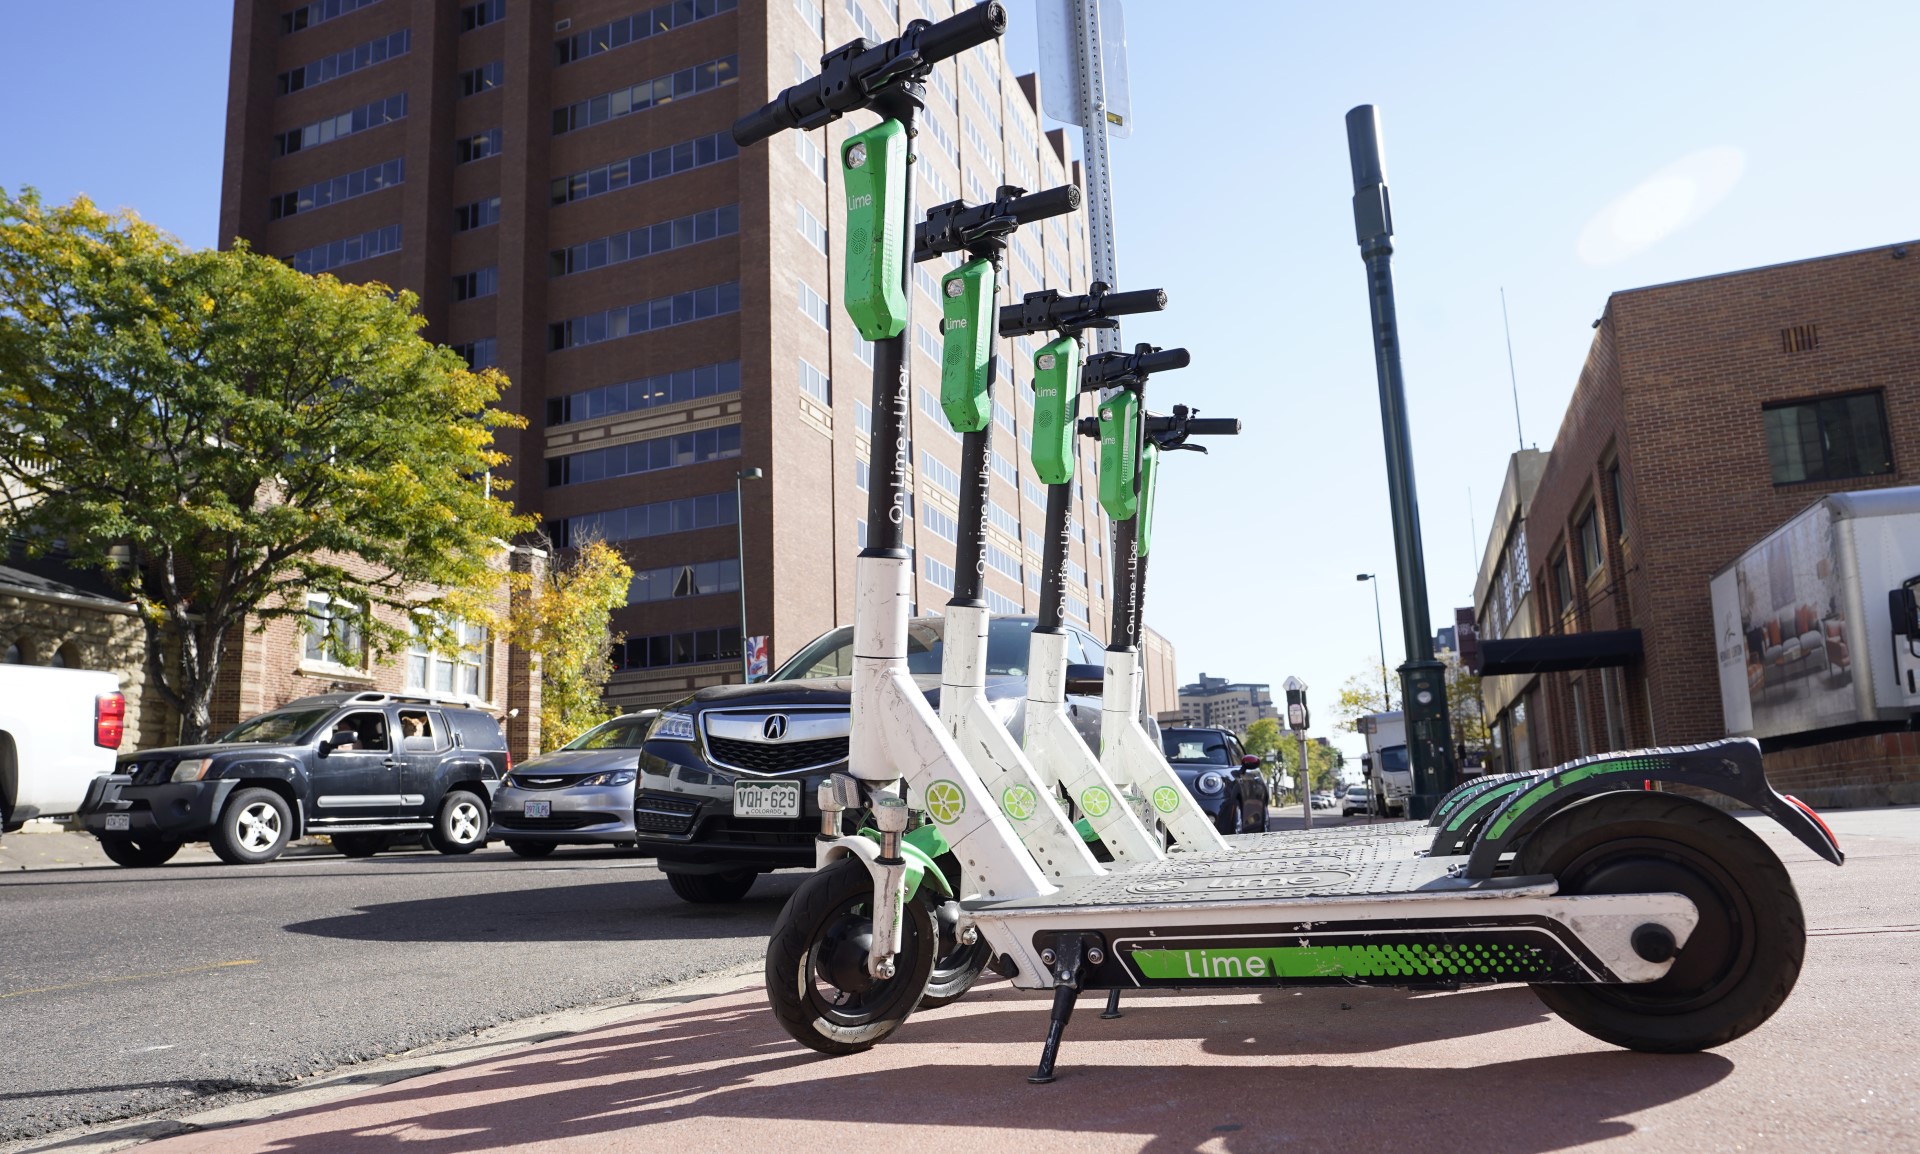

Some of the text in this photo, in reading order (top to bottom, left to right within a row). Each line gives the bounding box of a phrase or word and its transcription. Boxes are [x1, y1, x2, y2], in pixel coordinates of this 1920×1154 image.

[848, 193, 872, 211] Lime
[945, 317, 967, 330] Lime
[894, 364, 910, 416] Uber
[1036, 386, 1058, 397] Lime
[1101, 435, 1116, 445] Lime
[890, 436, 906, 487] Lime
[979, 447, 991, 487] Uber
[889, 492, 904, 524] On
[977, 506, 988, 547] Lime
[1061, 509, 1072, 545] Uber
[976, 550, 986, 579] On
[1128, 539, 1138, 571] Uber
[1057, 594, 1066, 619] On
[1127, 582, 1136, 613] Lime
[1126, 615, 1135, 635] On
[1207, 873, 1321, 889] Lime
[1184, 950, 1266, 978] Lime
